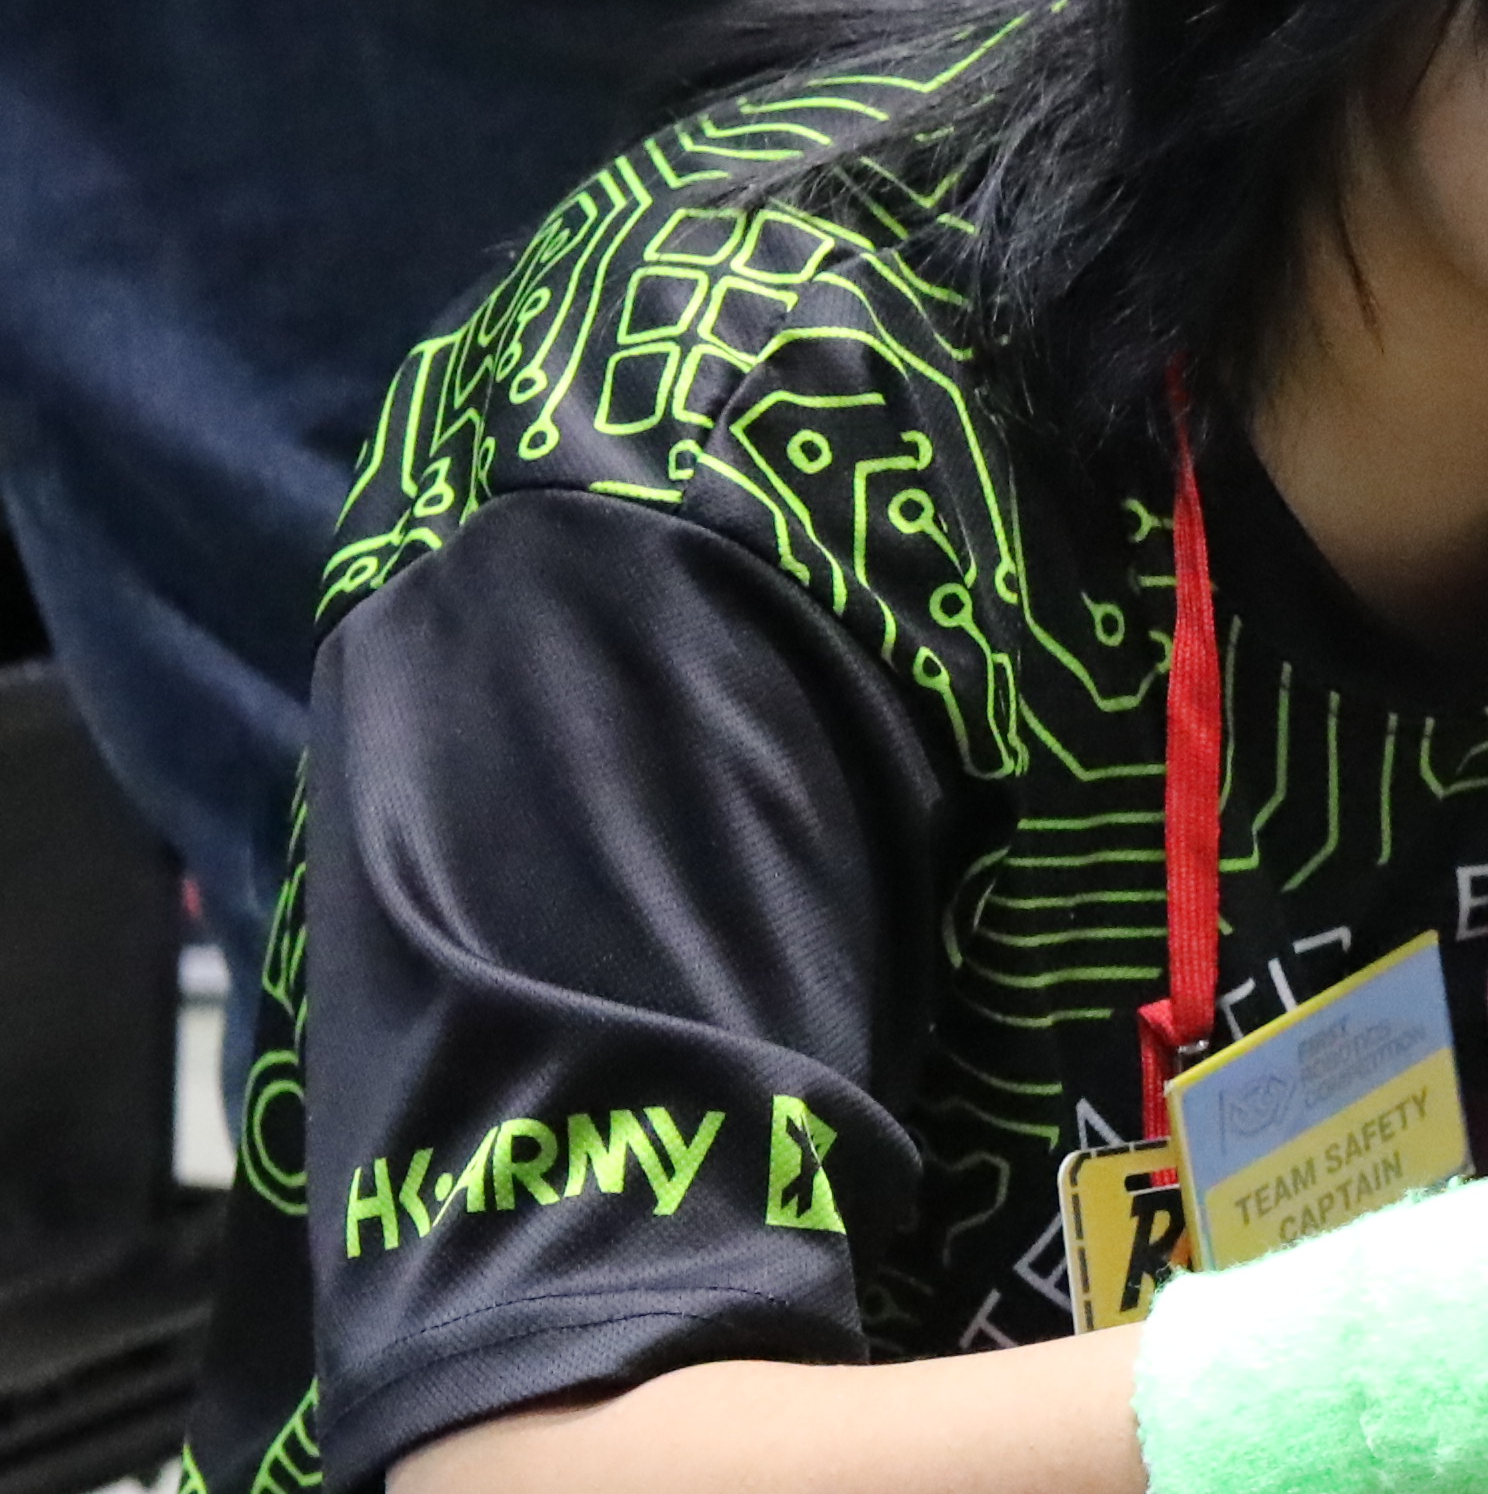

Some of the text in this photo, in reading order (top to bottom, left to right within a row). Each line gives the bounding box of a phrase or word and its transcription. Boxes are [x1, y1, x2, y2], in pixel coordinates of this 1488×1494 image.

[1234, 1085, 1429, 1227] TEAM SAFETY
[1278, 1150, 1404, 1243] CAPTAIN
